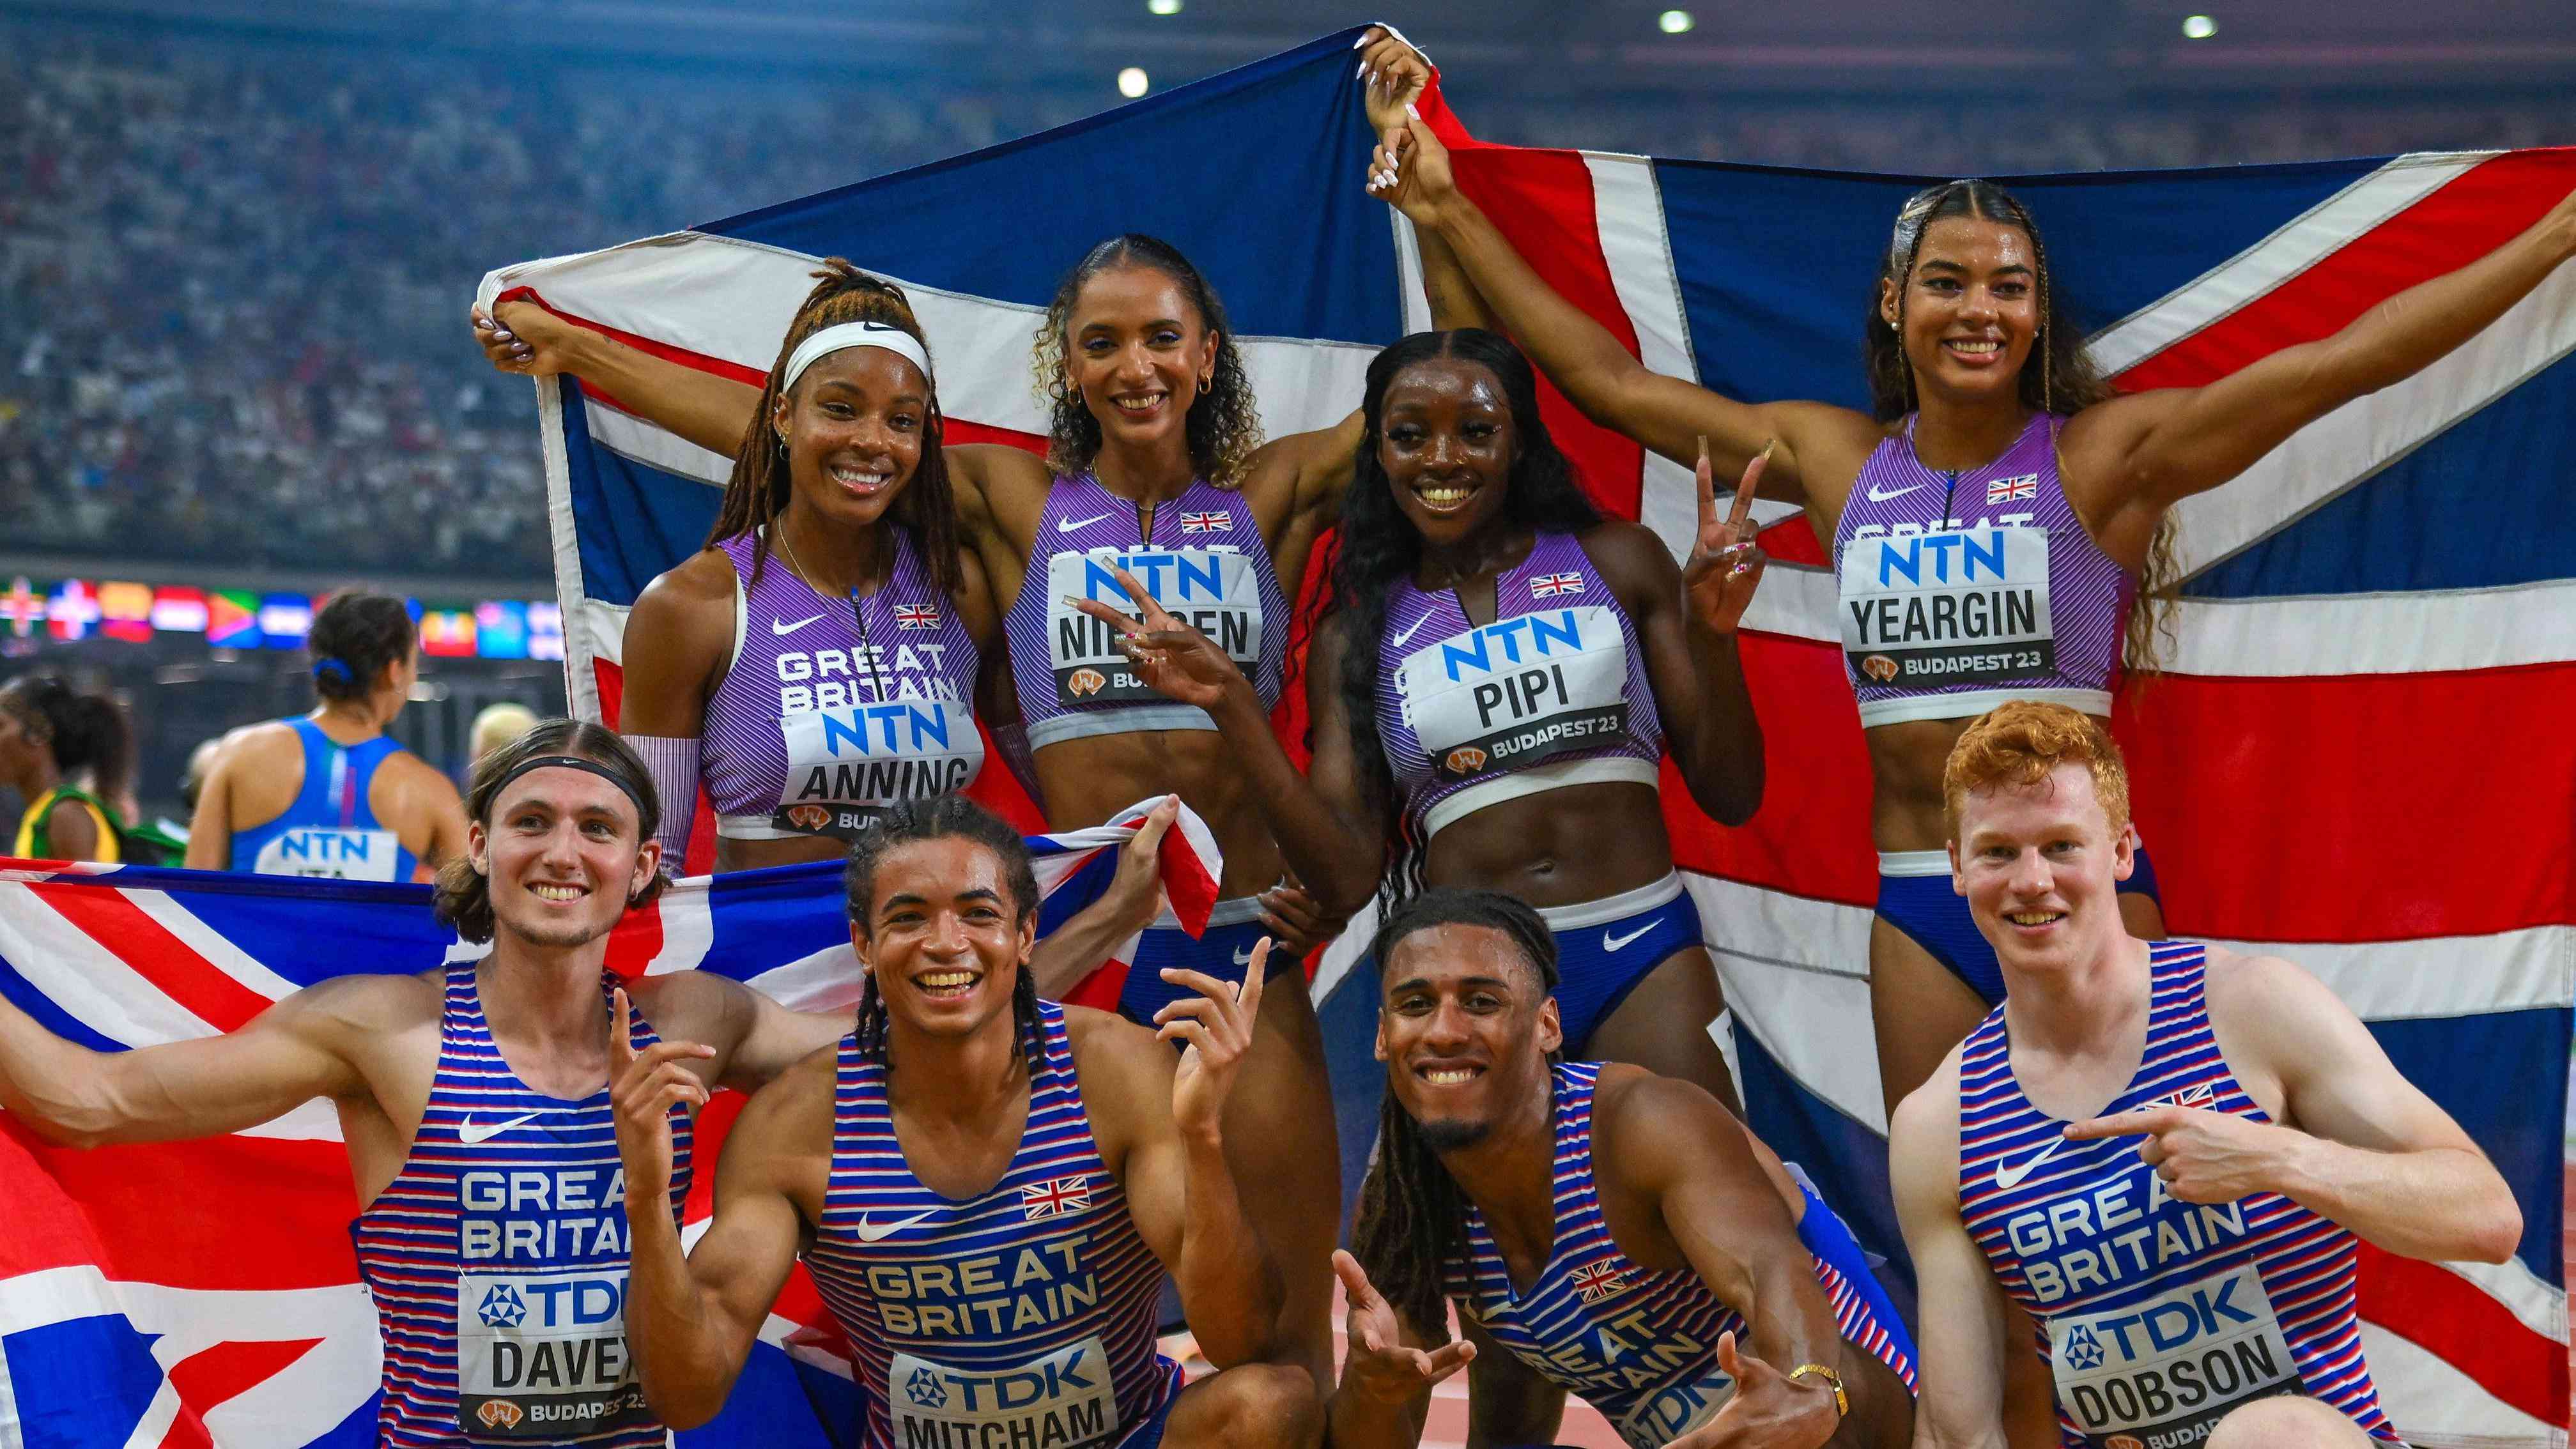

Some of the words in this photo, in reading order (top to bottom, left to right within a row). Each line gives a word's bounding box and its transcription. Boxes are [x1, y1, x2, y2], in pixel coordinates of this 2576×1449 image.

[1085, 555, 1222, 603] NTN
[1879, 531, 2005, 588] NTN
[1850, 590, 2037, 645] YEARGIN
[776, 644, 945, 682] GREAT
[1442, 610, 1582, 683] NTN
[1905, 653, 2012, 675] BUDAPEST
[2015, 651, 2042, 668] 23
[780, 677, 958, 716] BRITAIN
[1473, 664, 1570, 729] PIPI
[821, 704, 949, 757] NTN
[1492, 718, 1596, 760] BUDAPEST
[1598, 716, 1618, 733] 23
[798, 758, 968, 800] ANNING
[281, 832, 368, 861] NTN
[462, 1170, 625, 1211] GREA
[2008, 1170, 2184, 1257] GREA
[867, 1236, 1088, 1299] GREAT
[2024, 1201, 2246, 1303] BRITAIN
[878, 1273, 1098, 1335] BRITAIN
[2096, 1276, 2257, 1362] TDK
[945, 1348, 1096, 1412] TDK
[2071, 1334, 2279, 1429] DOBSON
[530, 1393, 625, 1422] BUDAPES
[903, 1397, 1105, 1449] MITCHAM
